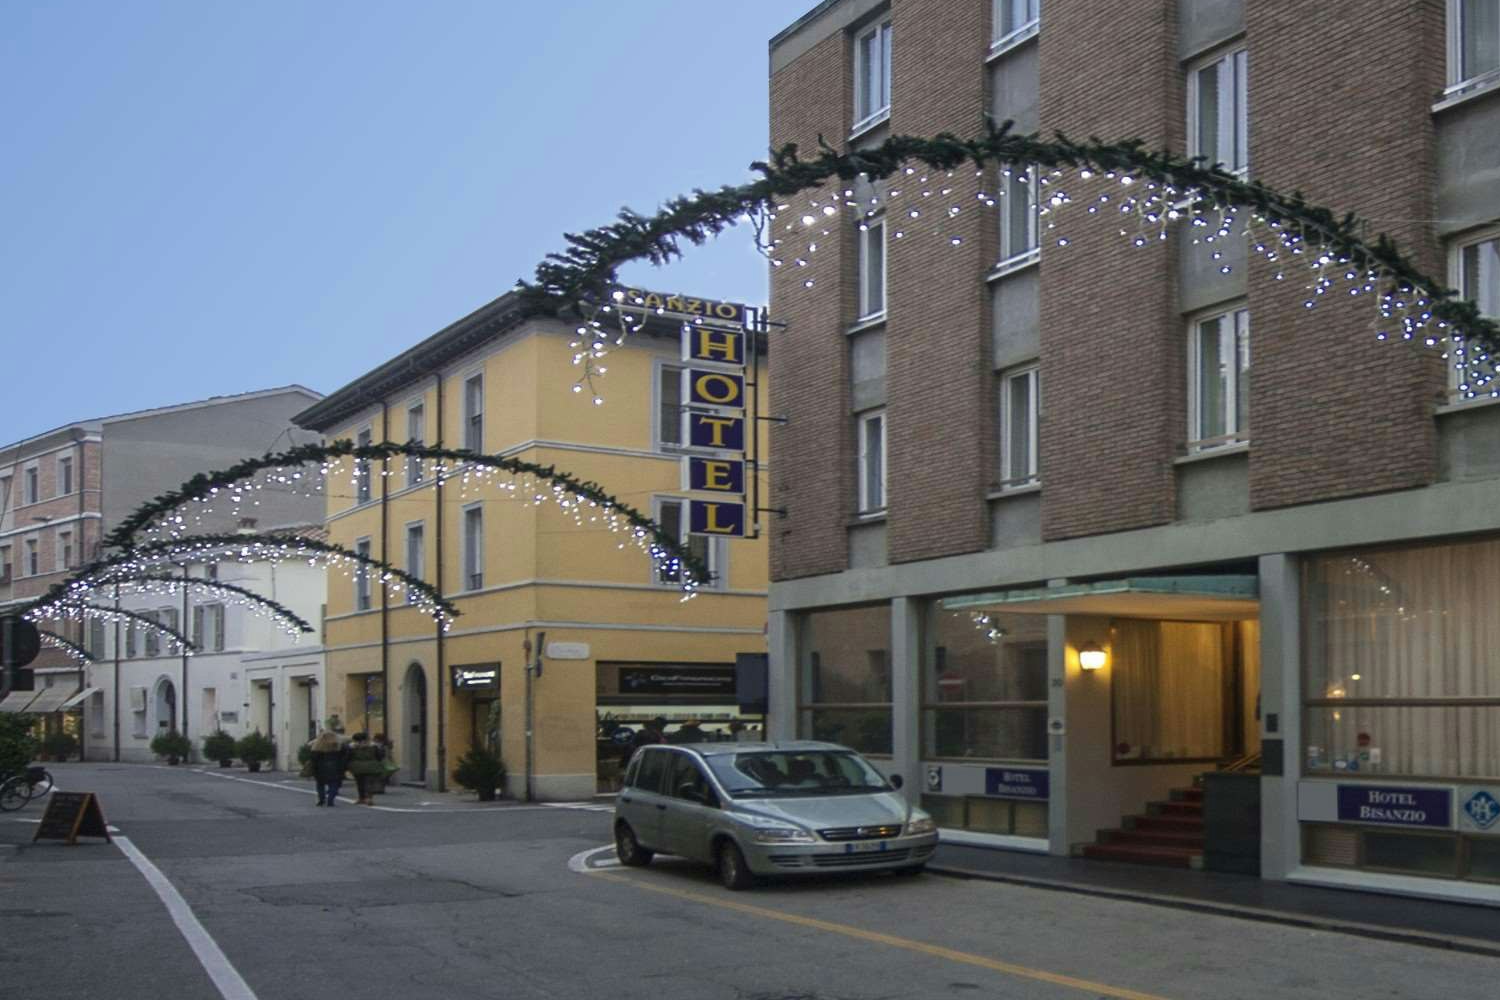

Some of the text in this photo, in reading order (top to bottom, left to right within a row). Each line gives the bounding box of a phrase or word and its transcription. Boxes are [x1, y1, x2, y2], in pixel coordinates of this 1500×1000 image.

[612, 286, 738, 320] SANZIO
[695, 328, 739, 534] HOTEL
[1368, 790, 1416, 806] HOTEL
[1359, 805, 1426, 822] BISANZIO
